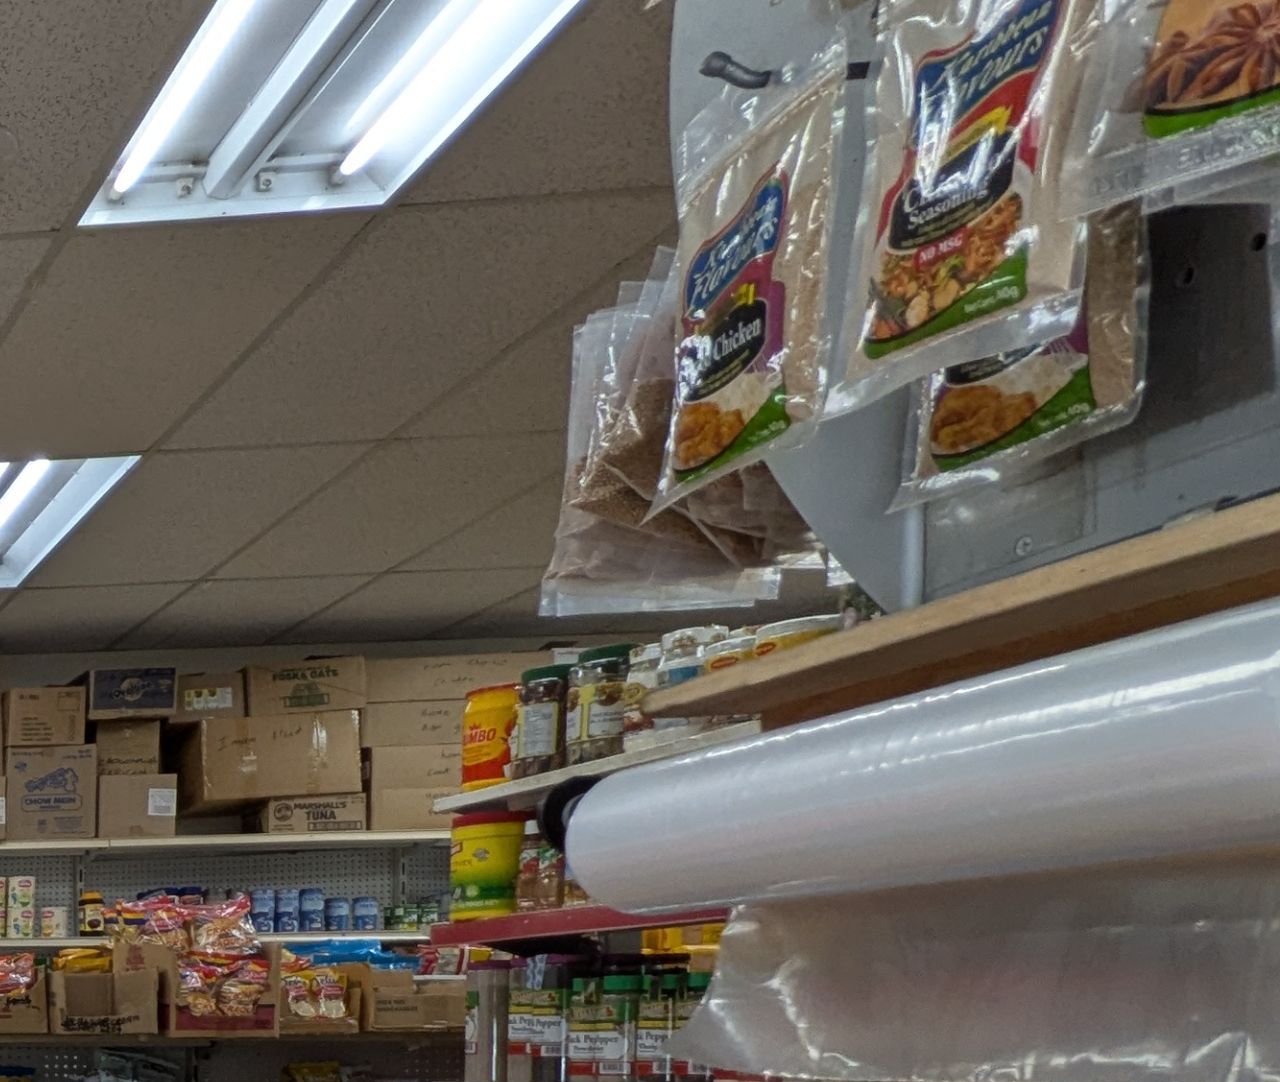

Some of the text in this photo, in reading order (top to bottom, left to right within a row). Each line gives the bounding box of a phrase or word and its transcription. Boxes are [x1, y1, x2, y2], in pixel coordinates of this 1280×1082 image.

[714, 318, 762, 360] Chicken
[294, 801, 347, 810] MARSHALL'S
[305, 810, 337, 821] TUNA
